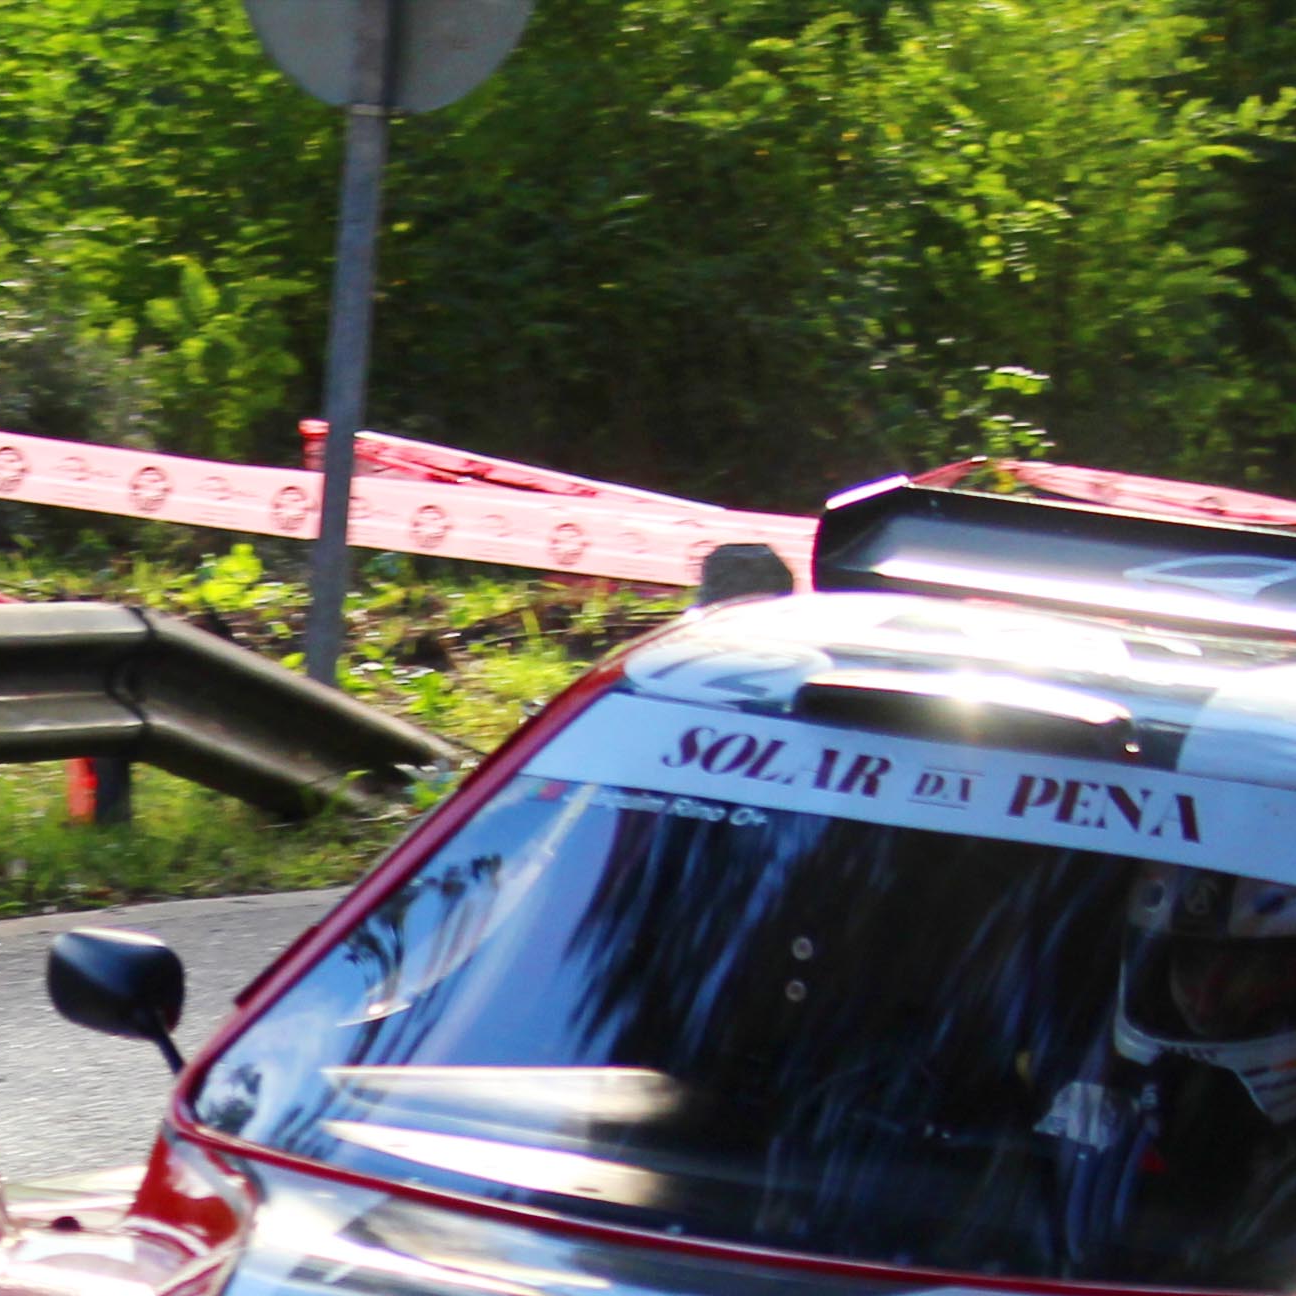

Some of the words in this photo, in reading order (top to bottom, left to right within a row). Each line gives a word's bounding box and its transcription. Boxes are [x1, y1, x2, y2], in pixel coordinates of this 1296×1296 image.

[661, 726, 893, 799] SOLAR
[914, 771, 973, 803] DA
[1008, 774, 1201, 844] PENA
